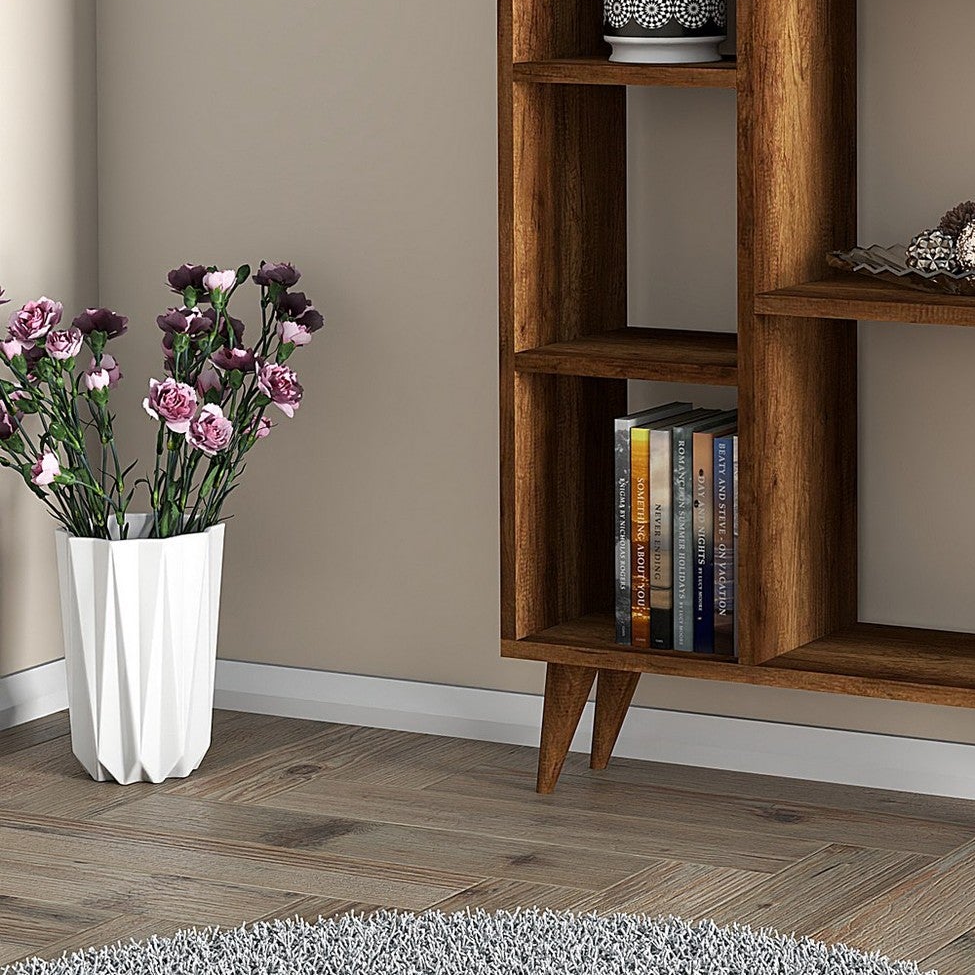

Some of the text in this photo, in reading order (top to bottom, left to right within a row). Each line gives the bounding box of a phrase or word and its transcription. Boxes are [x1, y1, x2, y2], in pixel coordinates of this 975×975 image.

[718, 443, 726, 475] BEATY
[697, 475, 705, 498] DAY
[718, 478, 726, 501] AND
[619, 510, 626, 520] BY
[697, 500, 705, 523] AND
[718, 503, 726, 535] STEVE
[637, 477, 646, 607] SOMETHING ABOUT YOU
[654, 504, 662, 581] NEVER ENDING
[678, 511, 686, 550] SUMMER
[697, 527, 706, 565] NIGHTS
[718, 543, 726, 559] ON
[678, 553, 686, 599] HOLIDAYS
[718, 562, 727, 616] VACATION
